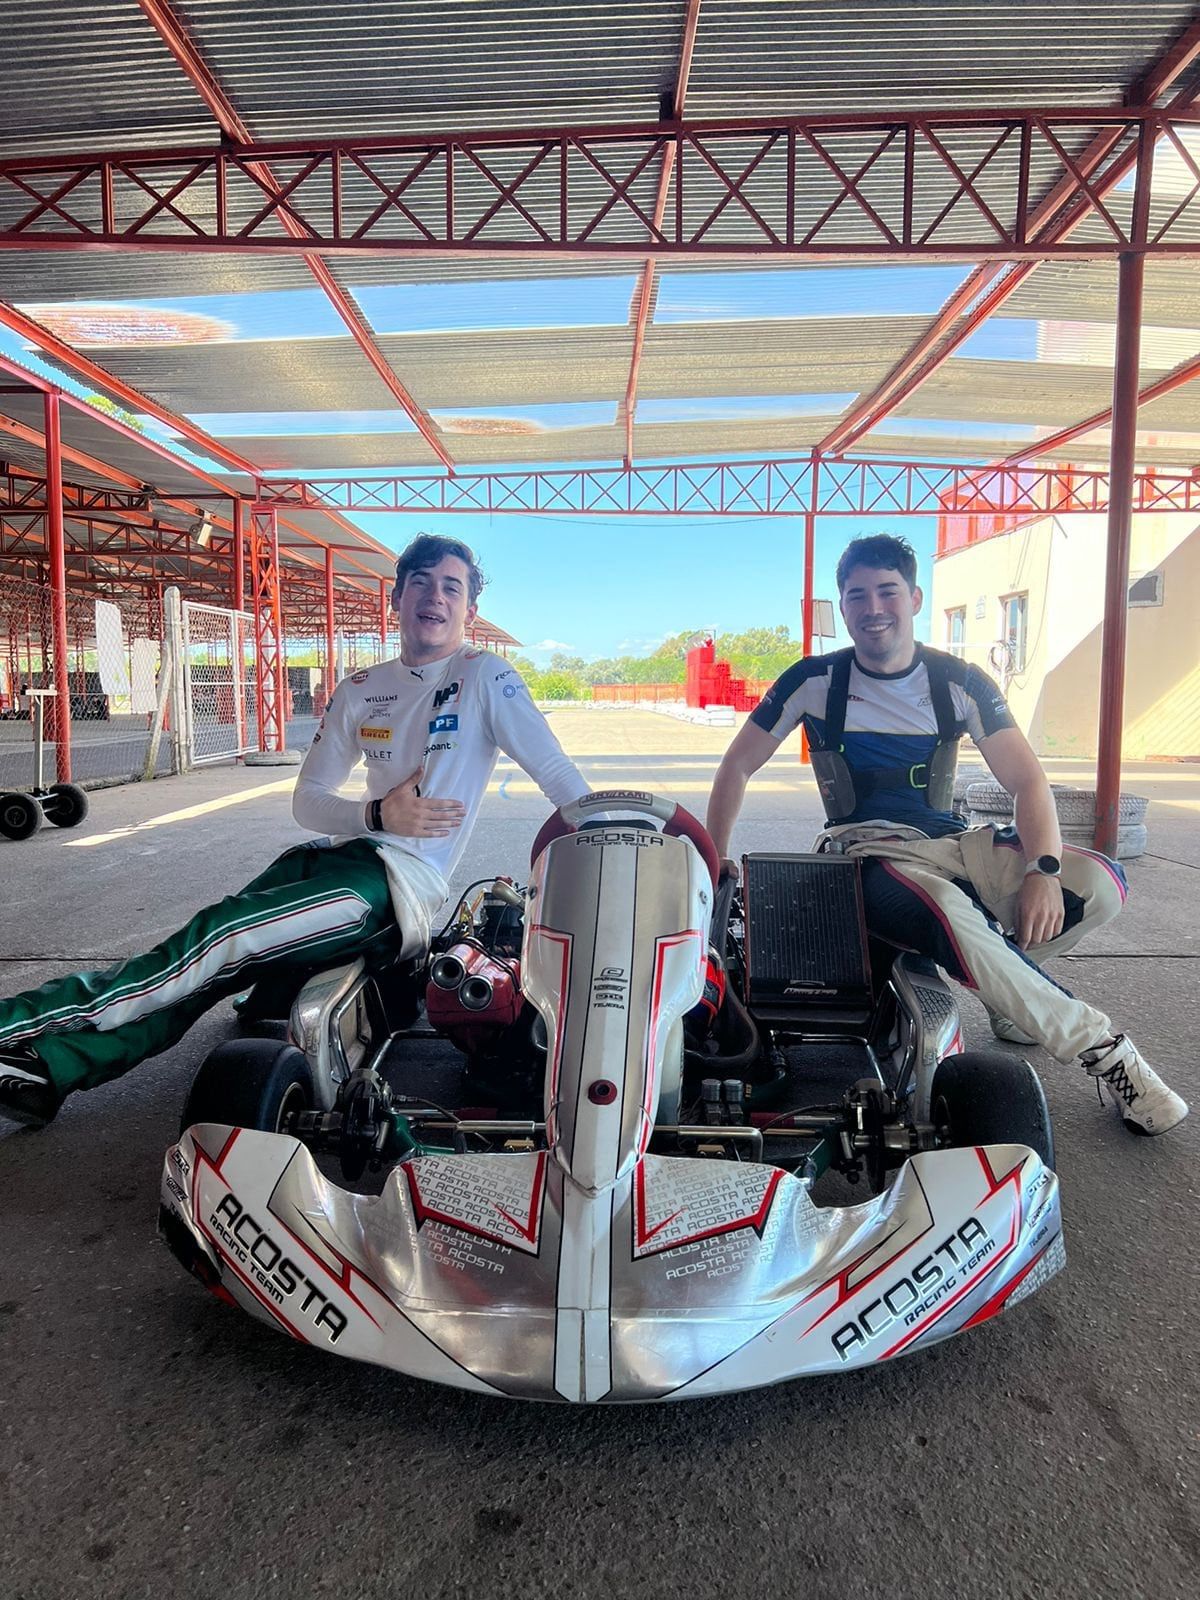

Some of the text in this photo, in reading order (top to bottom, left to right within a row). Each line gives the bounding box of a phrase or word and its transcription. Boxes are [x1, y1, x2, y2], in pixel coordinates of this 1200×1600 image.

[364, 695, 398, 704] WILLIAMS
[435, 717, 455, 729] PF
[576, 833, 664, 846] ACOSTA
[425, 1169, 470, 1189] ACOSTA
[473, 1185, 520, 1206] ACOSTA
[444, 1165, 498, 1190] ACOSTA
[418, 1185, 461, 1206] ACOSTA
[435, 1181, 490, 1206] ACOSTA
[680, 1191, 739, 1213] ACOSTA
[682, 1184, 731, 1203] ACOSTA
[427, 1199, 482, 1224] ACOSTA
[687, 1209, 746, 1232] ACOSTA
[688, 1201, 738, 1221] ACOSTA
[427, 1230, 473, 1251] ACOSTA
[701, 1240, 750, 1259] ACOSTA
[209, 1214, 285, 1305] RACING TEAM
[215, 1193, 349, 1345] ACOSTA
[448, 1248, 505, 1275] ACOSTA
[666, 1255, 726, 1280] ACOSTA
[831, 1217, 989, 1362] ACOSTA
[904, 1277, 957, 1326] RACING
[959, 1239, 996, 1275] TEAM
